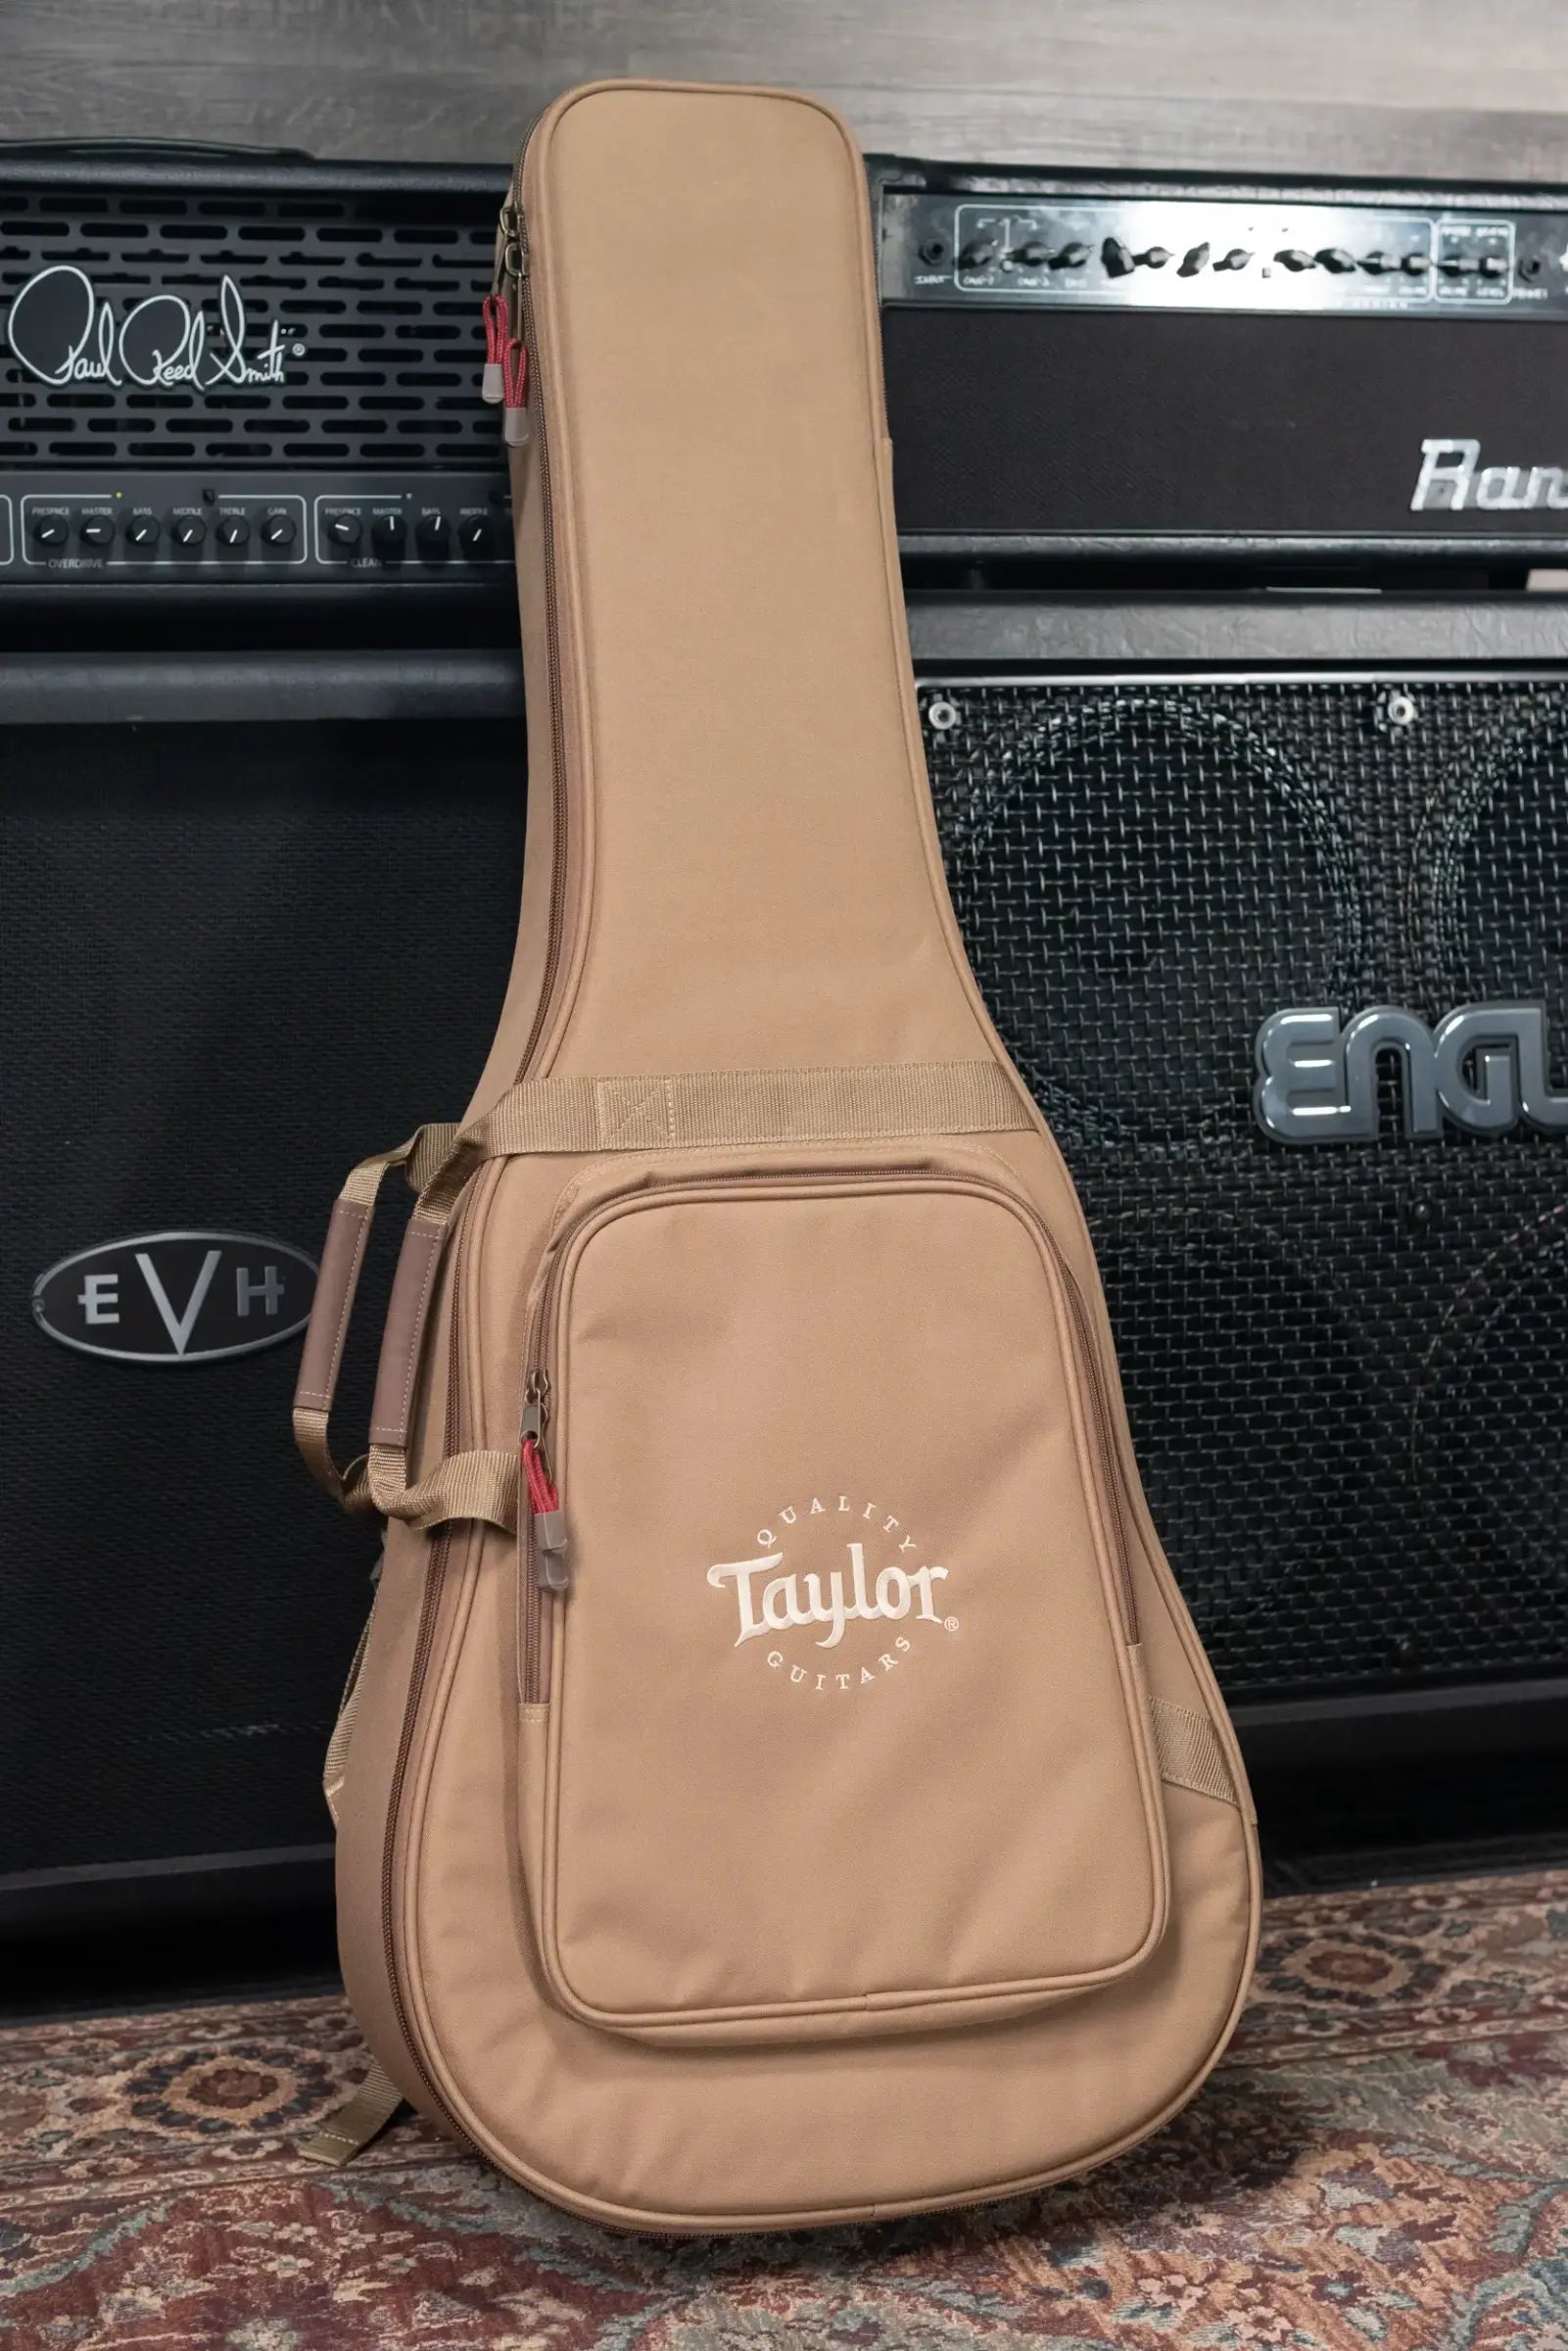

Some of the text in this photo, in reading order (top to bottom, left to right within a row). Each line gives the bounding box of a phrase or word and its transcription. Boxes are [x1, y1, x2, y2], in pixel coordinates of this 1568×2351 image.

[8, 264, 286, 391] Paul Reed Smith
[81, 506, 113, 516] MASTER
[132, 506, 153, 516] BASS
[267, 506, 288, 516] GAIN
[48, 558, 104, 569] OVERDRIVE
[350, 556, 382, 568] CLEAN
[77, 1250, 285, 1357] EVH
[756, 1495, 918, 1554] QUALITY
[706, 1542, 949, 1649] Taylor
[766, 1635, 912, 1692] GUITARS
